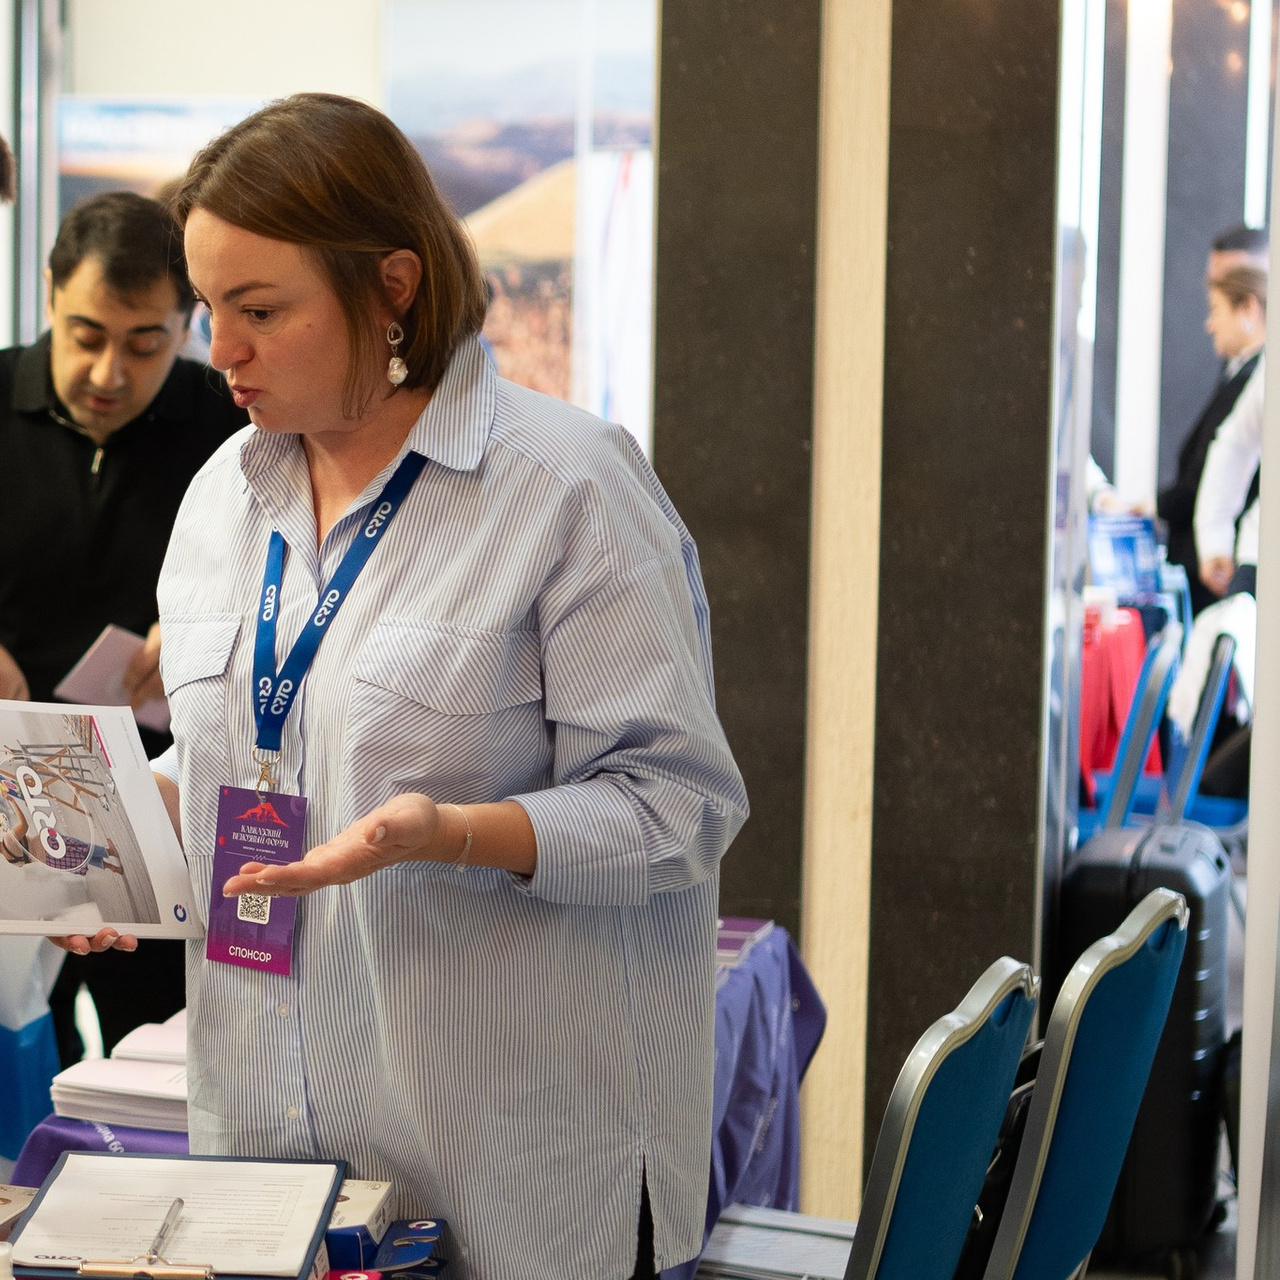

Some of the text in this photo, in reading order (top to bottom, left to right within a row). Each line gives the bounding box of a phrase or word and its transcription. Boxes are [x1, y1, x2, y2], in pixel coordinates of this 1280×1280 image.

[365, 501, 392, 538] ORTO
[263, 584, 276, 621] ORTO
[314, 588, 340, 626] ORTO
[271, 679, 293, 715] ORTO
[16, 765, 66, 859] ORTO
[228, 945, 272, 963] СПОНСОР
